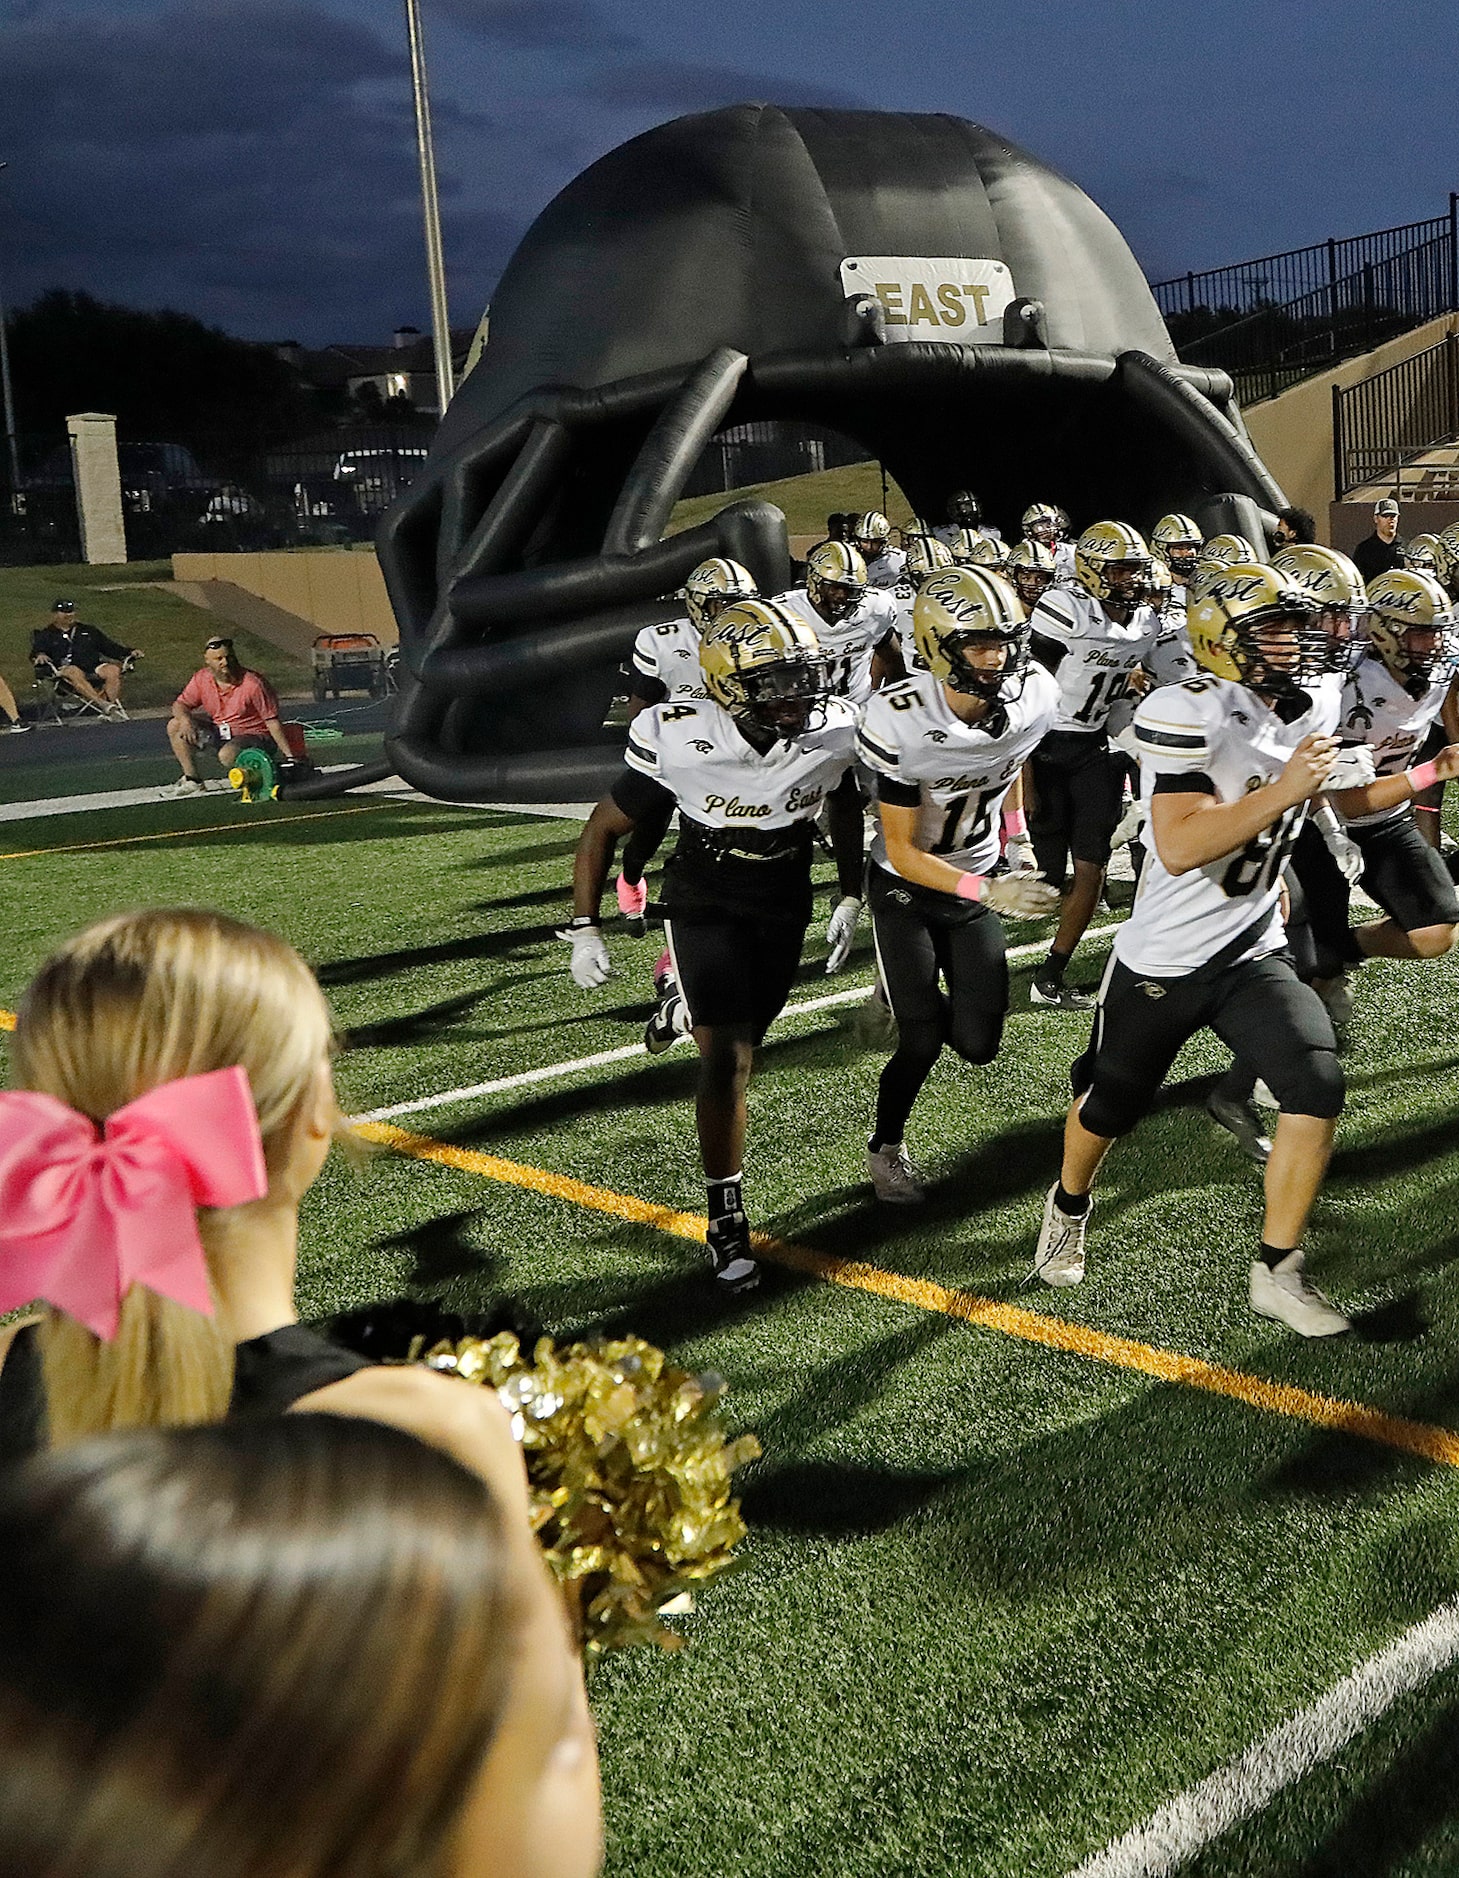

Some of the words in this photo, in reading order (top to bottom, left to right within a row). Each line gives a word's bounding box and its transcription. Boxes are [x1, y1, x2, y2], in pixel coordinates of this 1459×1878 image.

[875, 283, 990, 326] EAST
[688, 566, 719, 585] ast
[925, 573, 986, 623] East
[1083, 650, 1120, 669] Plano
[661, 705, 697, 723] 4
[928, 773, 991, 792] Plano
[702, 794, 772, 818] Plano
[785, 785, 824, 814] East
